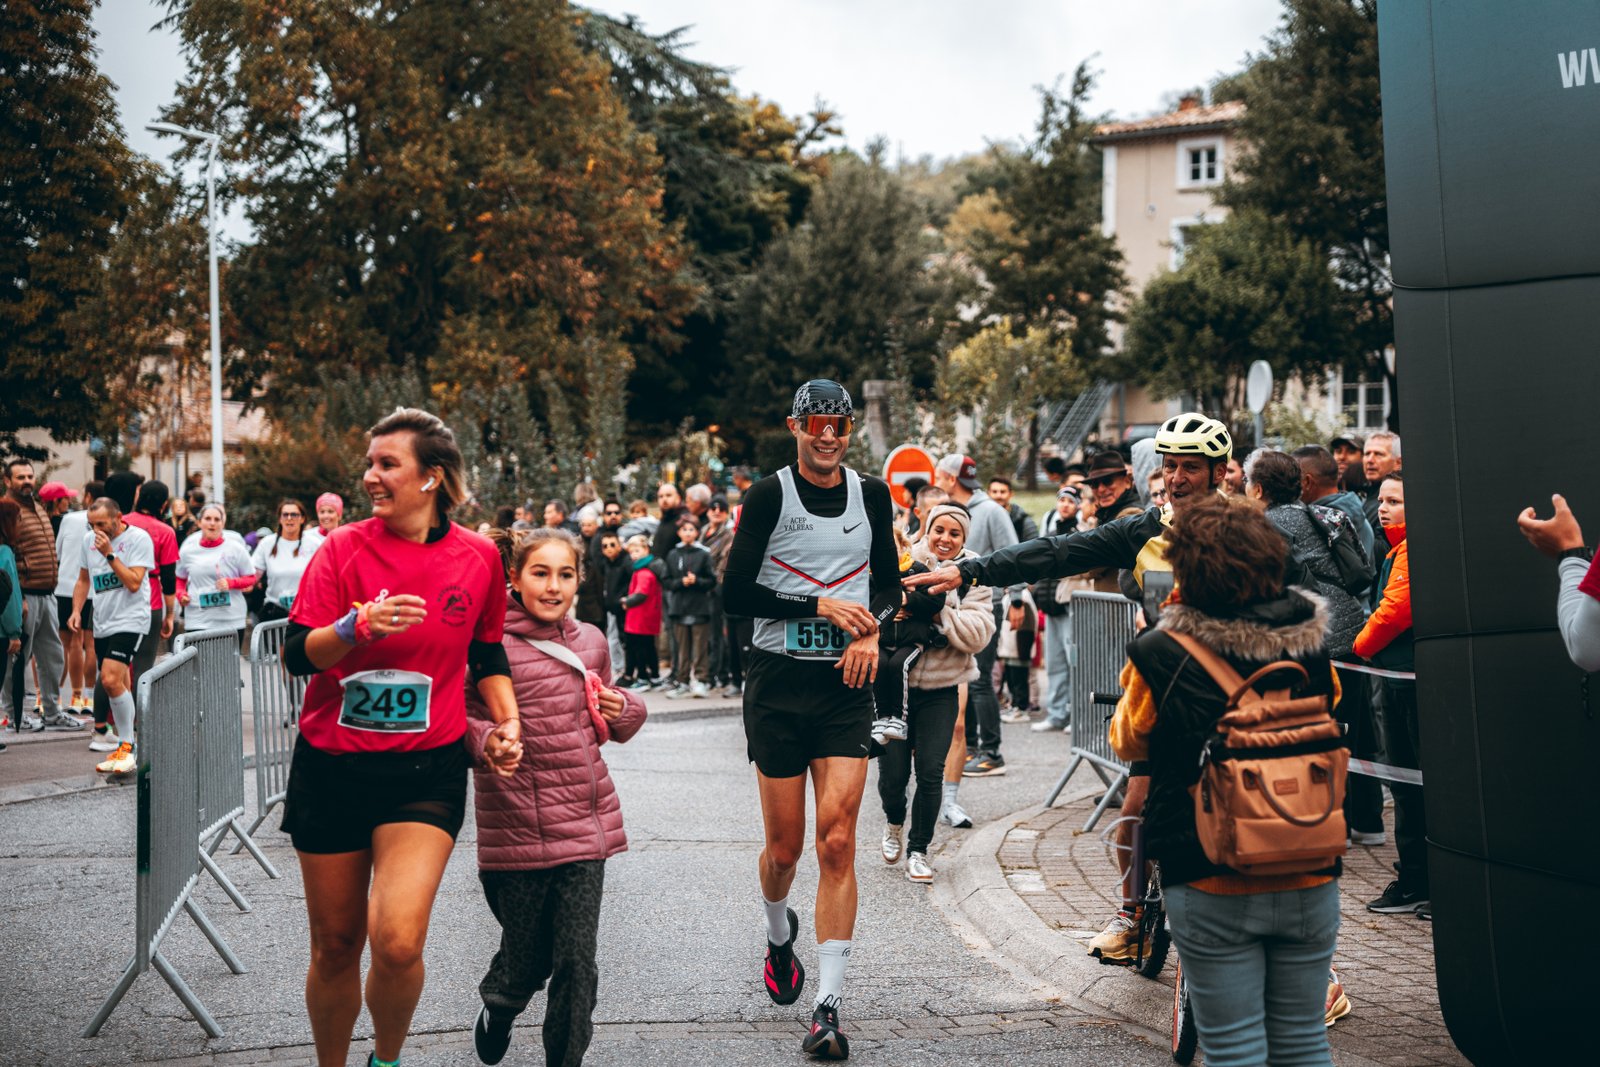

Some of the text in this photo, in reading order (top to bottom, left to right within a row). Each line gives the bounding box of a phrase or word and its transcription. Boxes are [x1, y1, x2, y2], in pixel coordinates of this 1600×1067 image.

[96, 572, 119, 588] 166
[203, 592, 227, 605] 165
[797, 622, 845, 649] 558
[352, 685, 418, 718] 249
